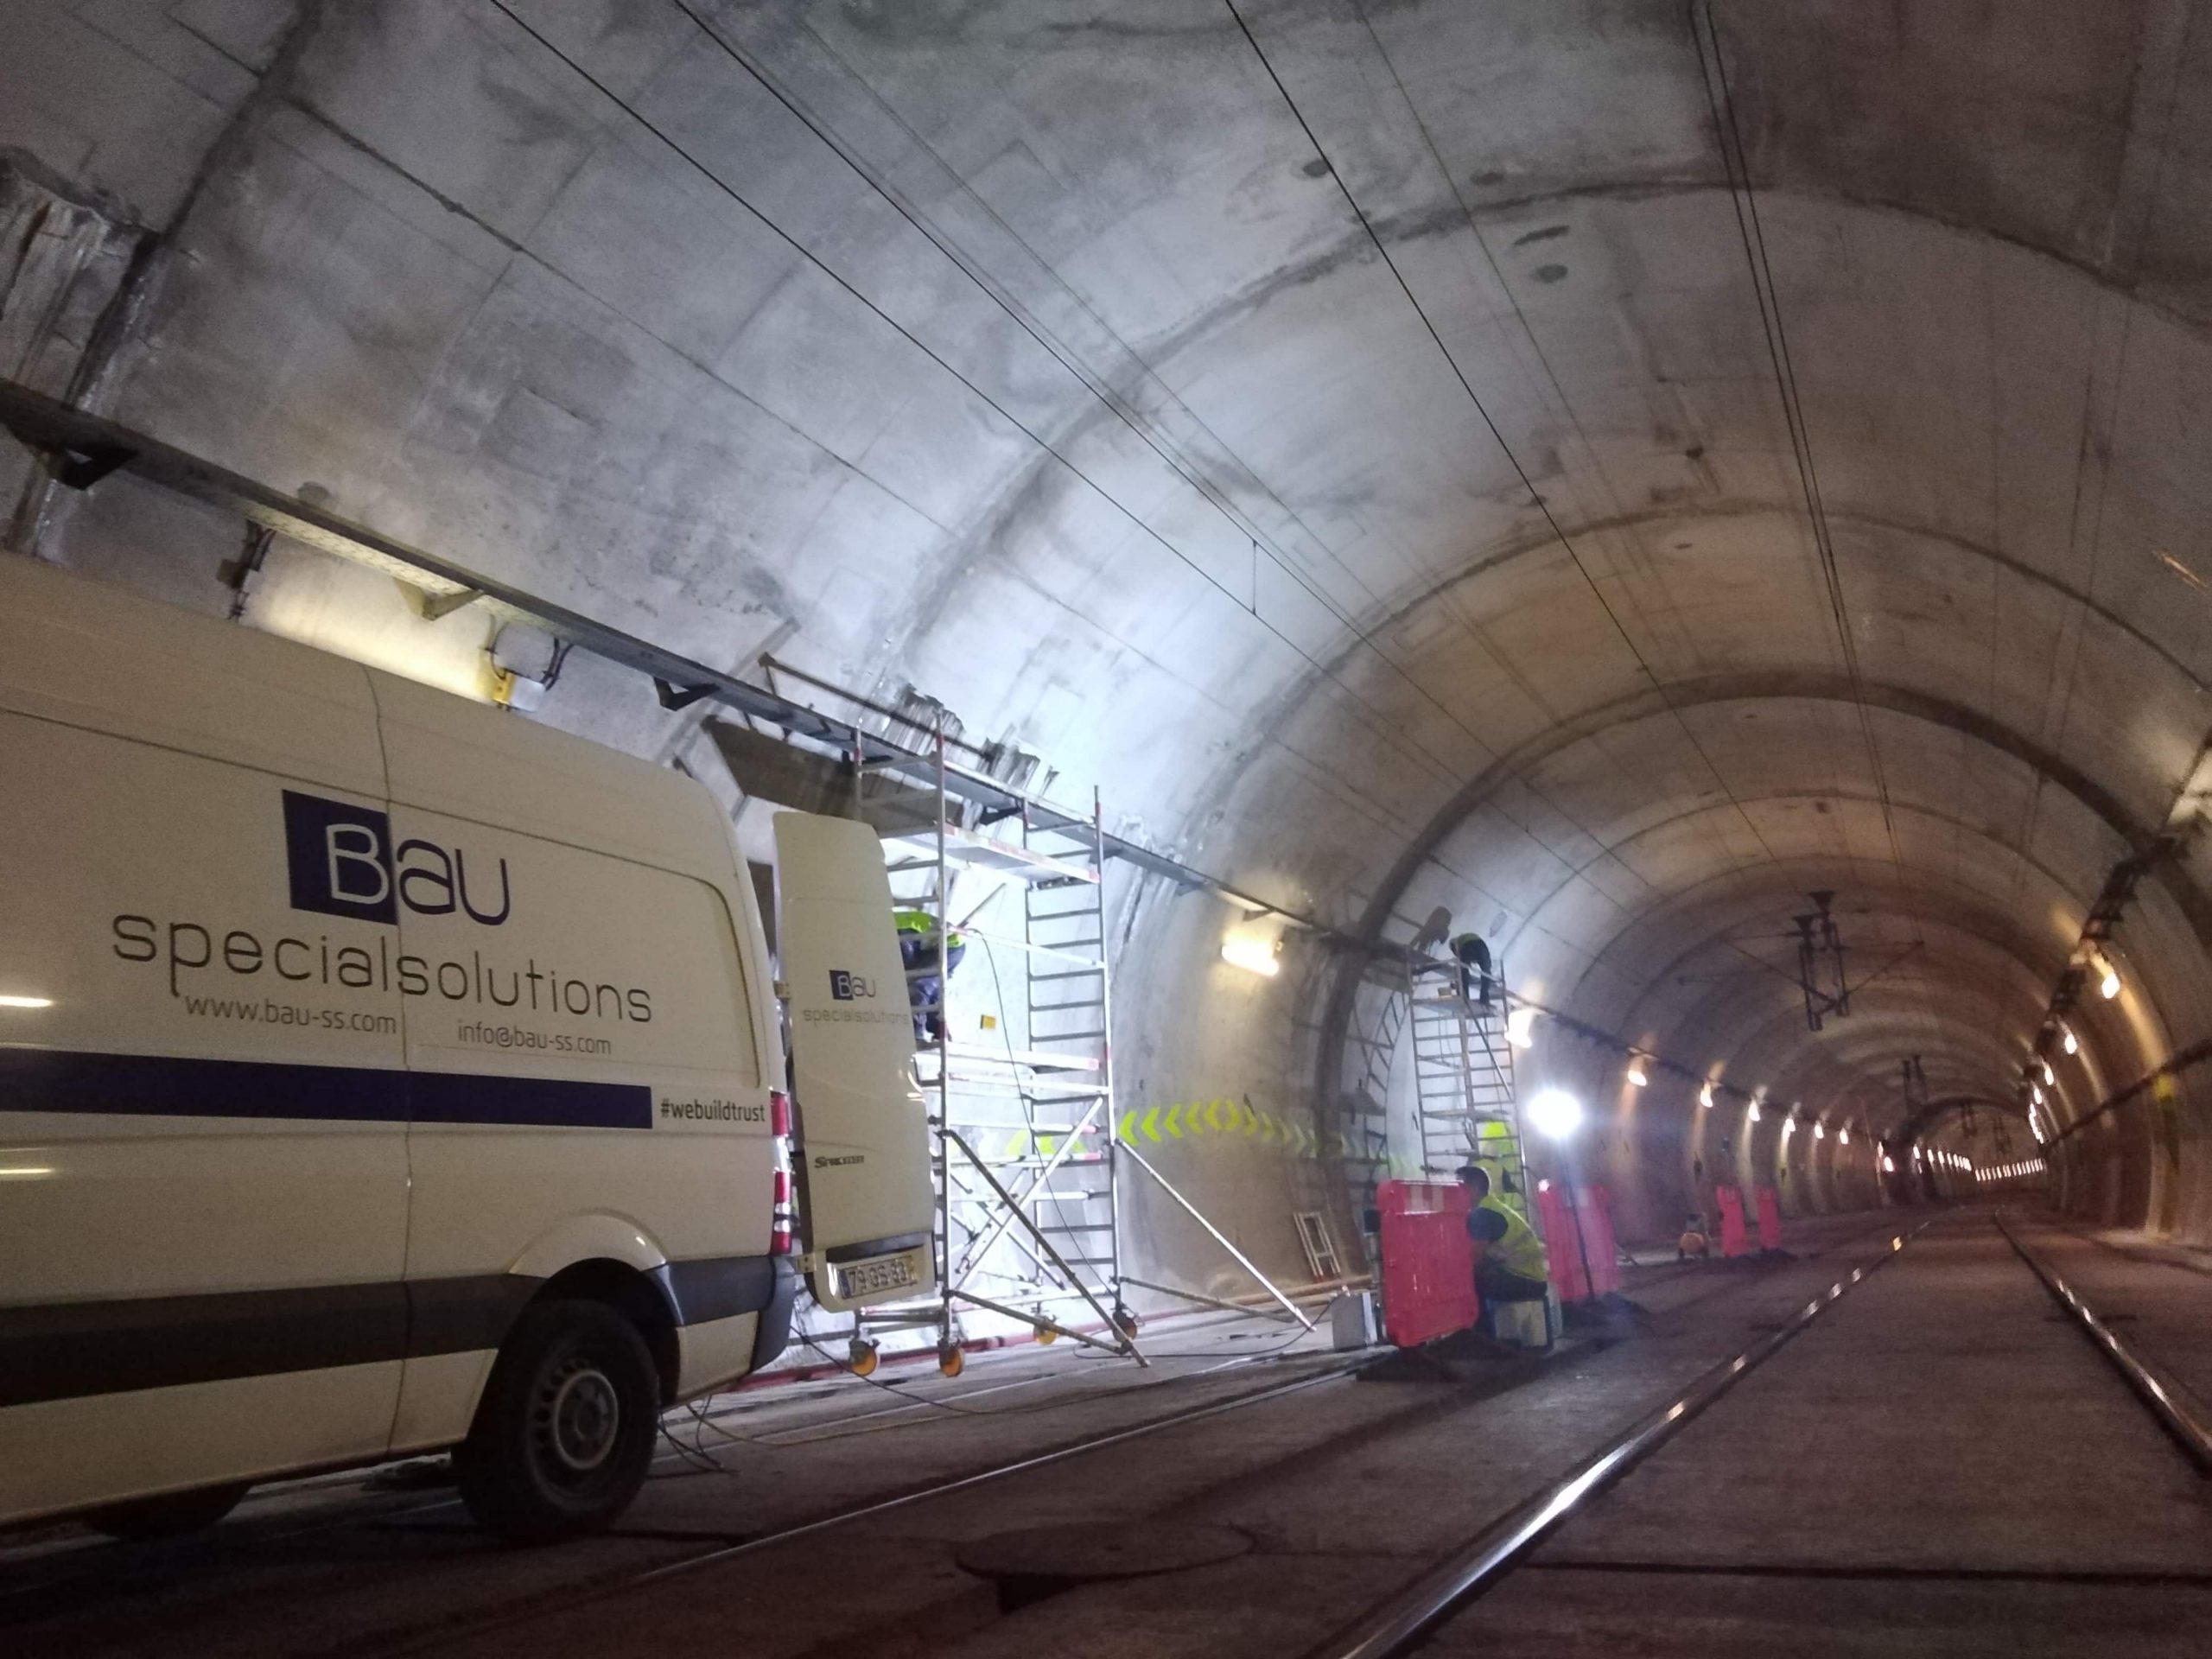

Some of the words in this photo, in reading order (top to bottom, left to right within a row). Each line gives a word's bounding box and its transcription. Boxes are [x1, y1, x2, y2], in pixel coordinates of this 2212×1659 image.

[113, 914, 652, 1023] specialsolutions
[185, 995, 397, 1033] www.bau-ss.com
[458, 1020, 612, 1055] info@bau-ss.com
[660, 1097, 766, 1122] #webuildtrust
